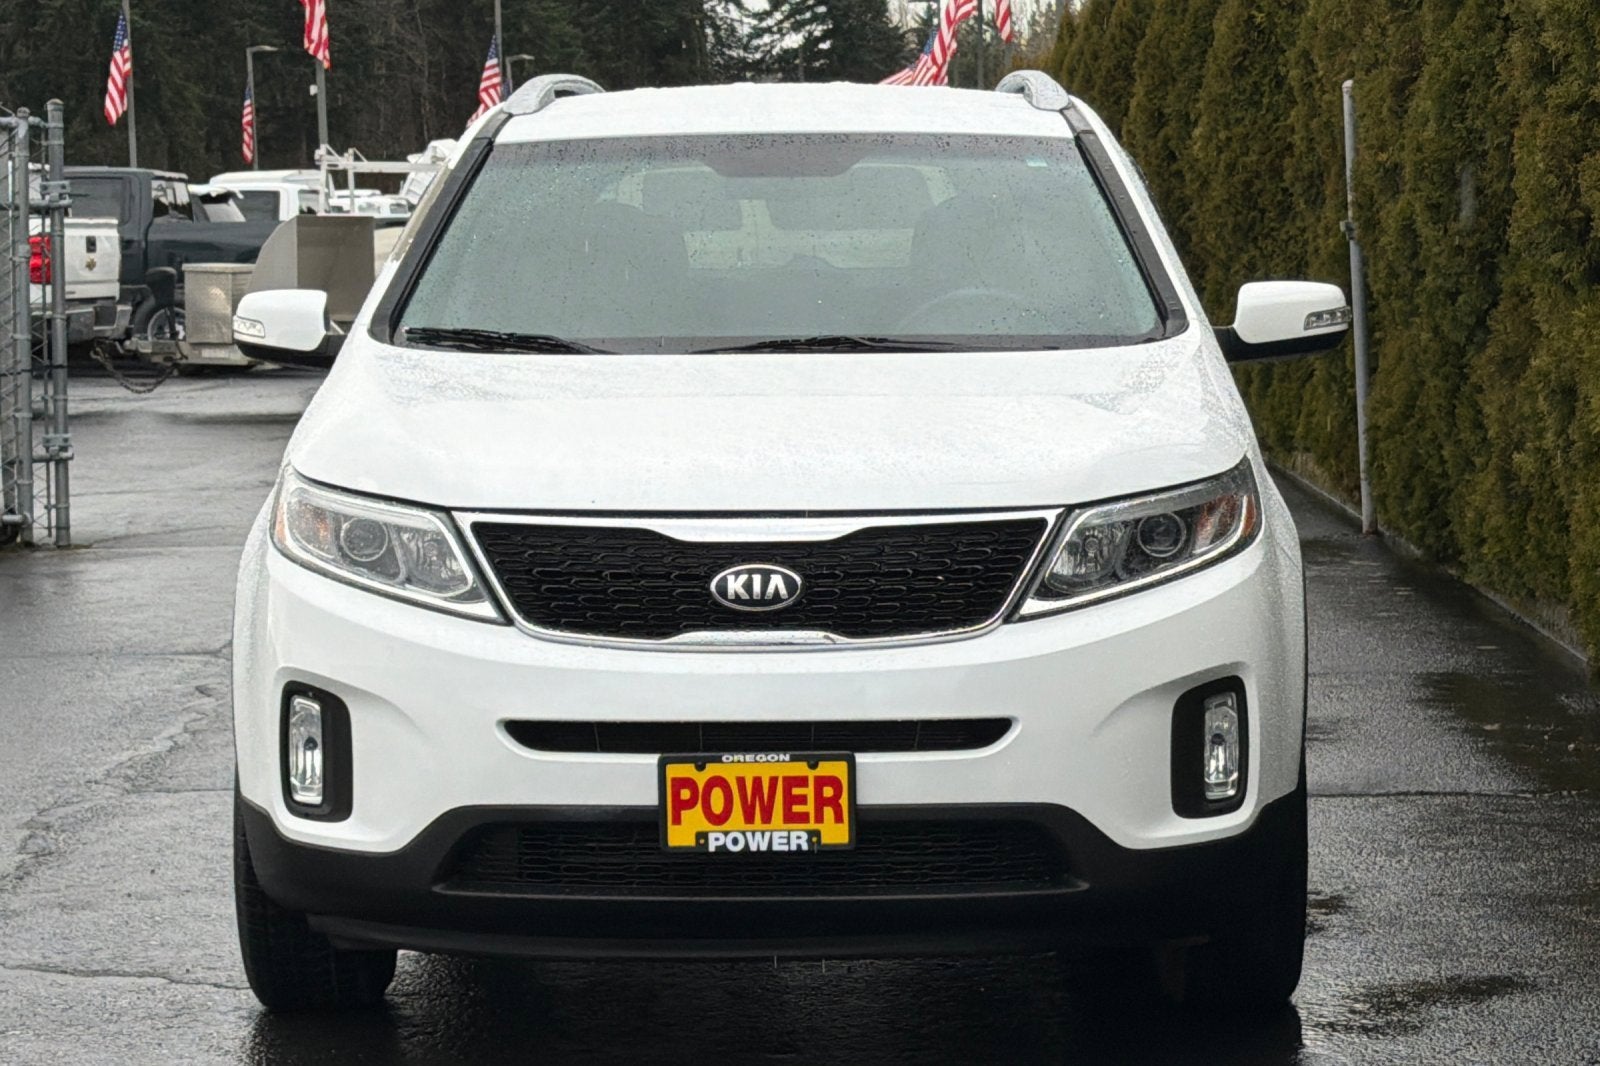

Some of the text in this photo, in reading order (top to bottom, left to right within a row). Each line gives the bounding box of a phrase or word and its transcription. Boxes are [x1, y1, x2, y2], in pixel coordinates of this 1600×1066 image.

[726, 573, 789, 600] KIA
[721, 753, 791, 763] OREGON
[670, 775, 845, 826] POWER
[707, 831, 809, 852] POWER
